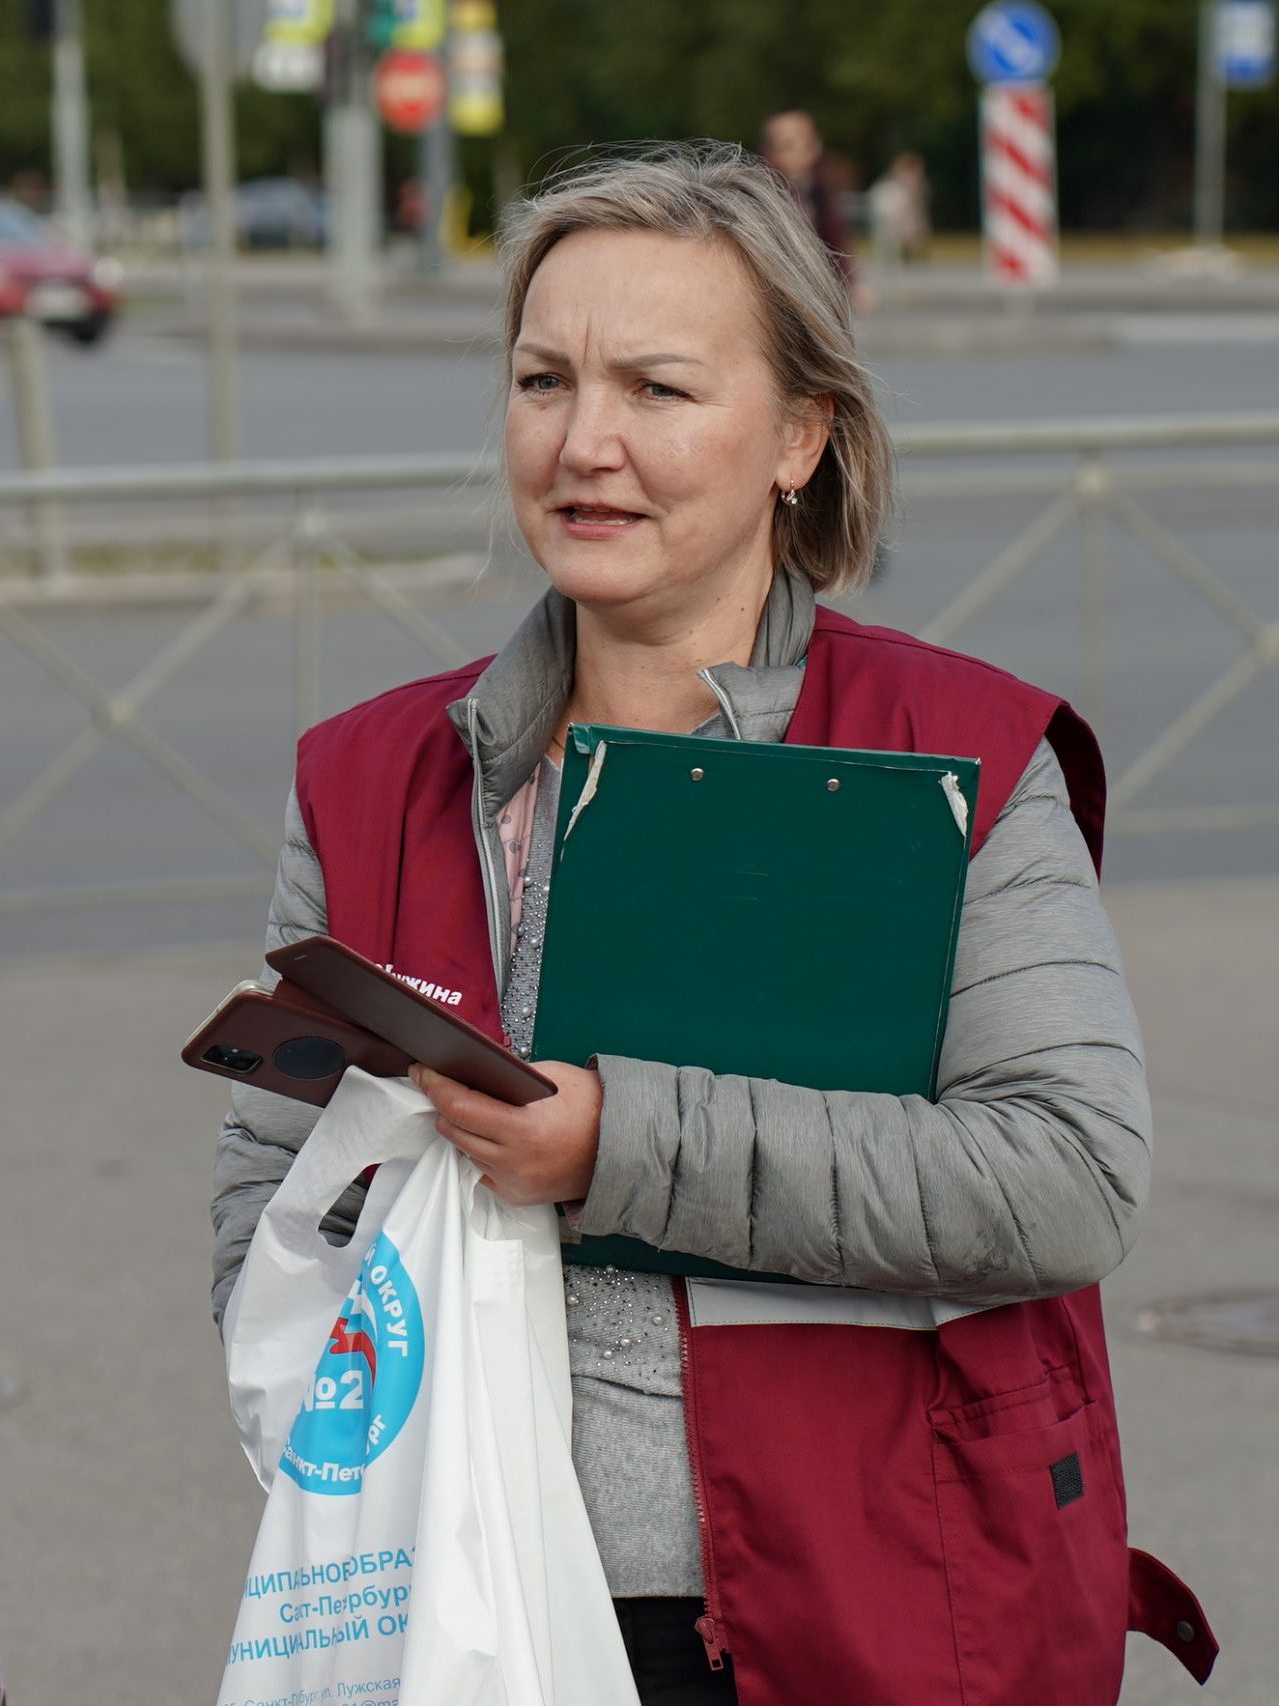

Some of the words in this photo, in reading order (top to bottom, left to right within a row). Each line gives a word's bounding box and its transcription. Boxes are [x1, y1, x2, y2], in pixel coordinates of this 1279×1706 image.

[370, 1264, 409, 1357] ОКРУГ
[347, 1545, 417, 1577] ОБРА
[337, 1677, 402, 1699] Лужская
